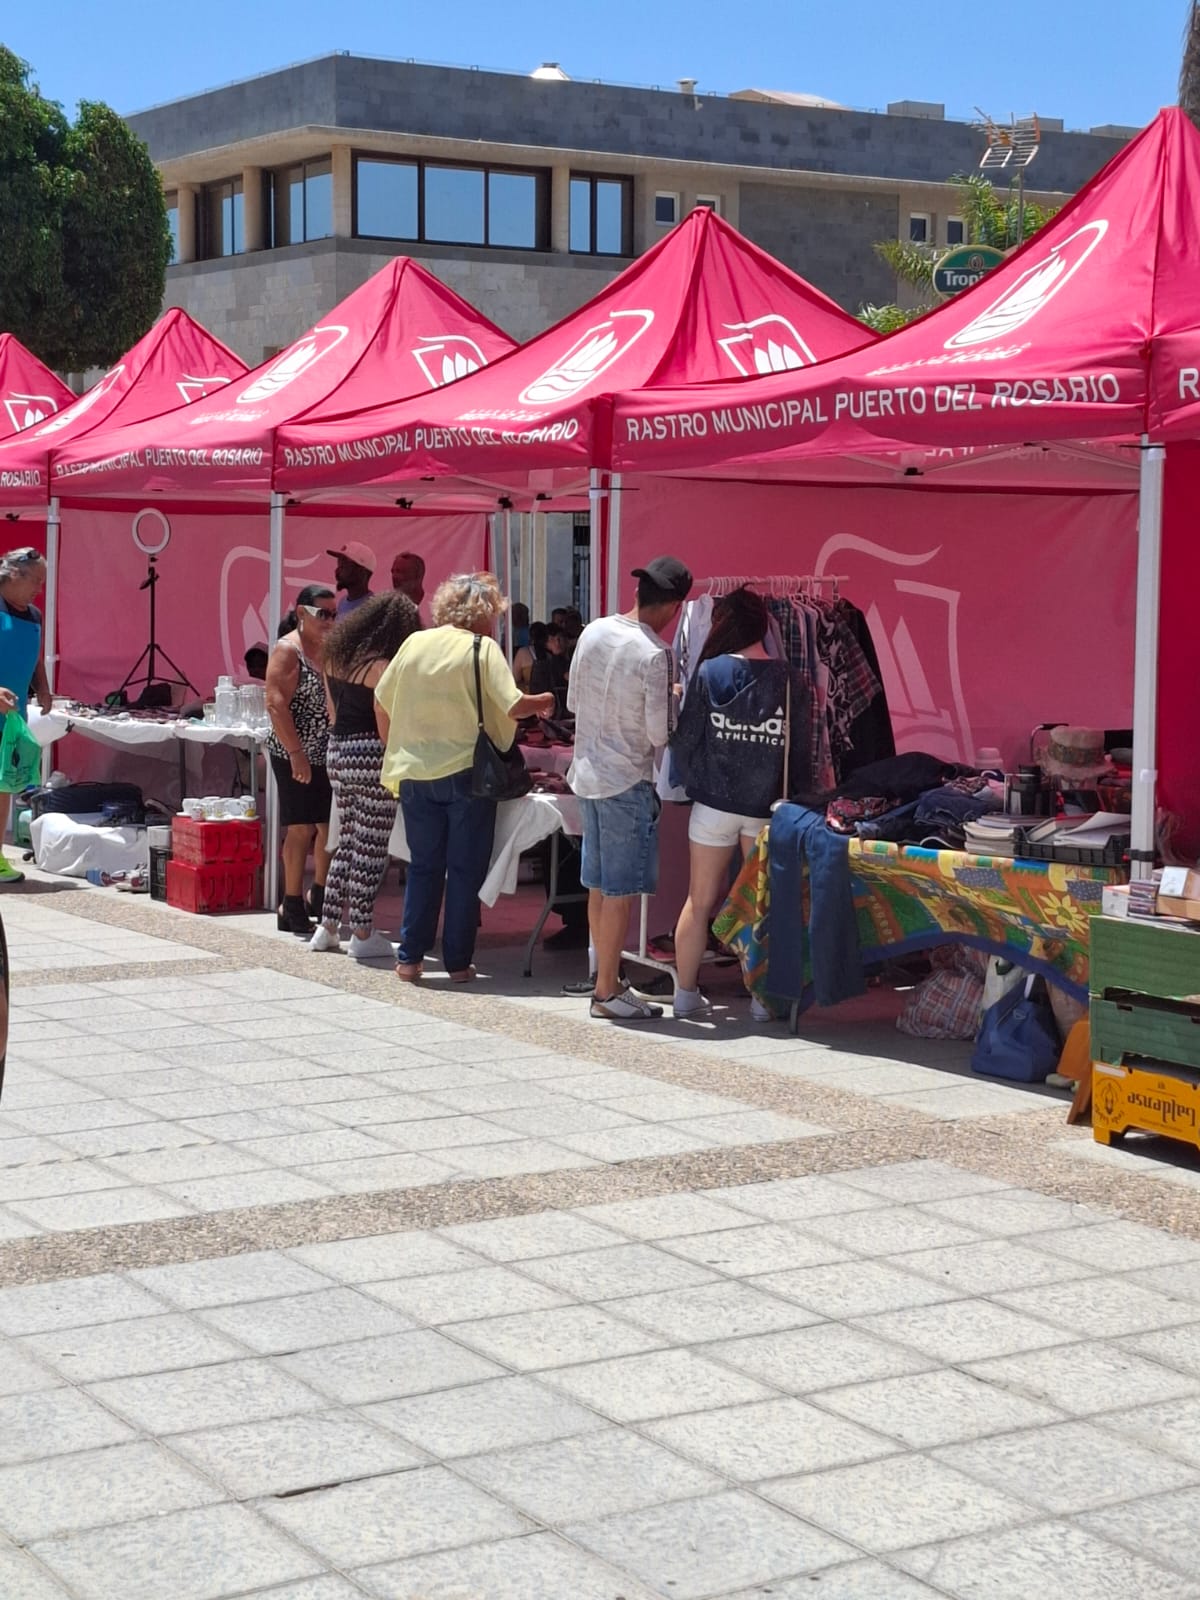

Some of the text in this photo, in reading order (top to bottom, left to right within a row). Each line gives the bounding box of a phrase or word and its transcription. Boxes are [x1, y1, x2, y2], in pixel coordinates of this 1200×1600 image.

[626, 373, 1120, 442] RASTRO MUNICIPAL PUERTO DEL ROSARIO
[145, 448, 187, 467] PUERTO
[188, 448, 211, 467] DEL
[211, 447, 263, 466] ROSARIO
[284, 445, 336, 467] RASTRO
[336, 431, 412, 462] MUNICIPAL
[415, 426, 472, 451] PUERTO
[470, 427, 501, 446] DEL
[0, 470, 41, 487] ROSARIO
